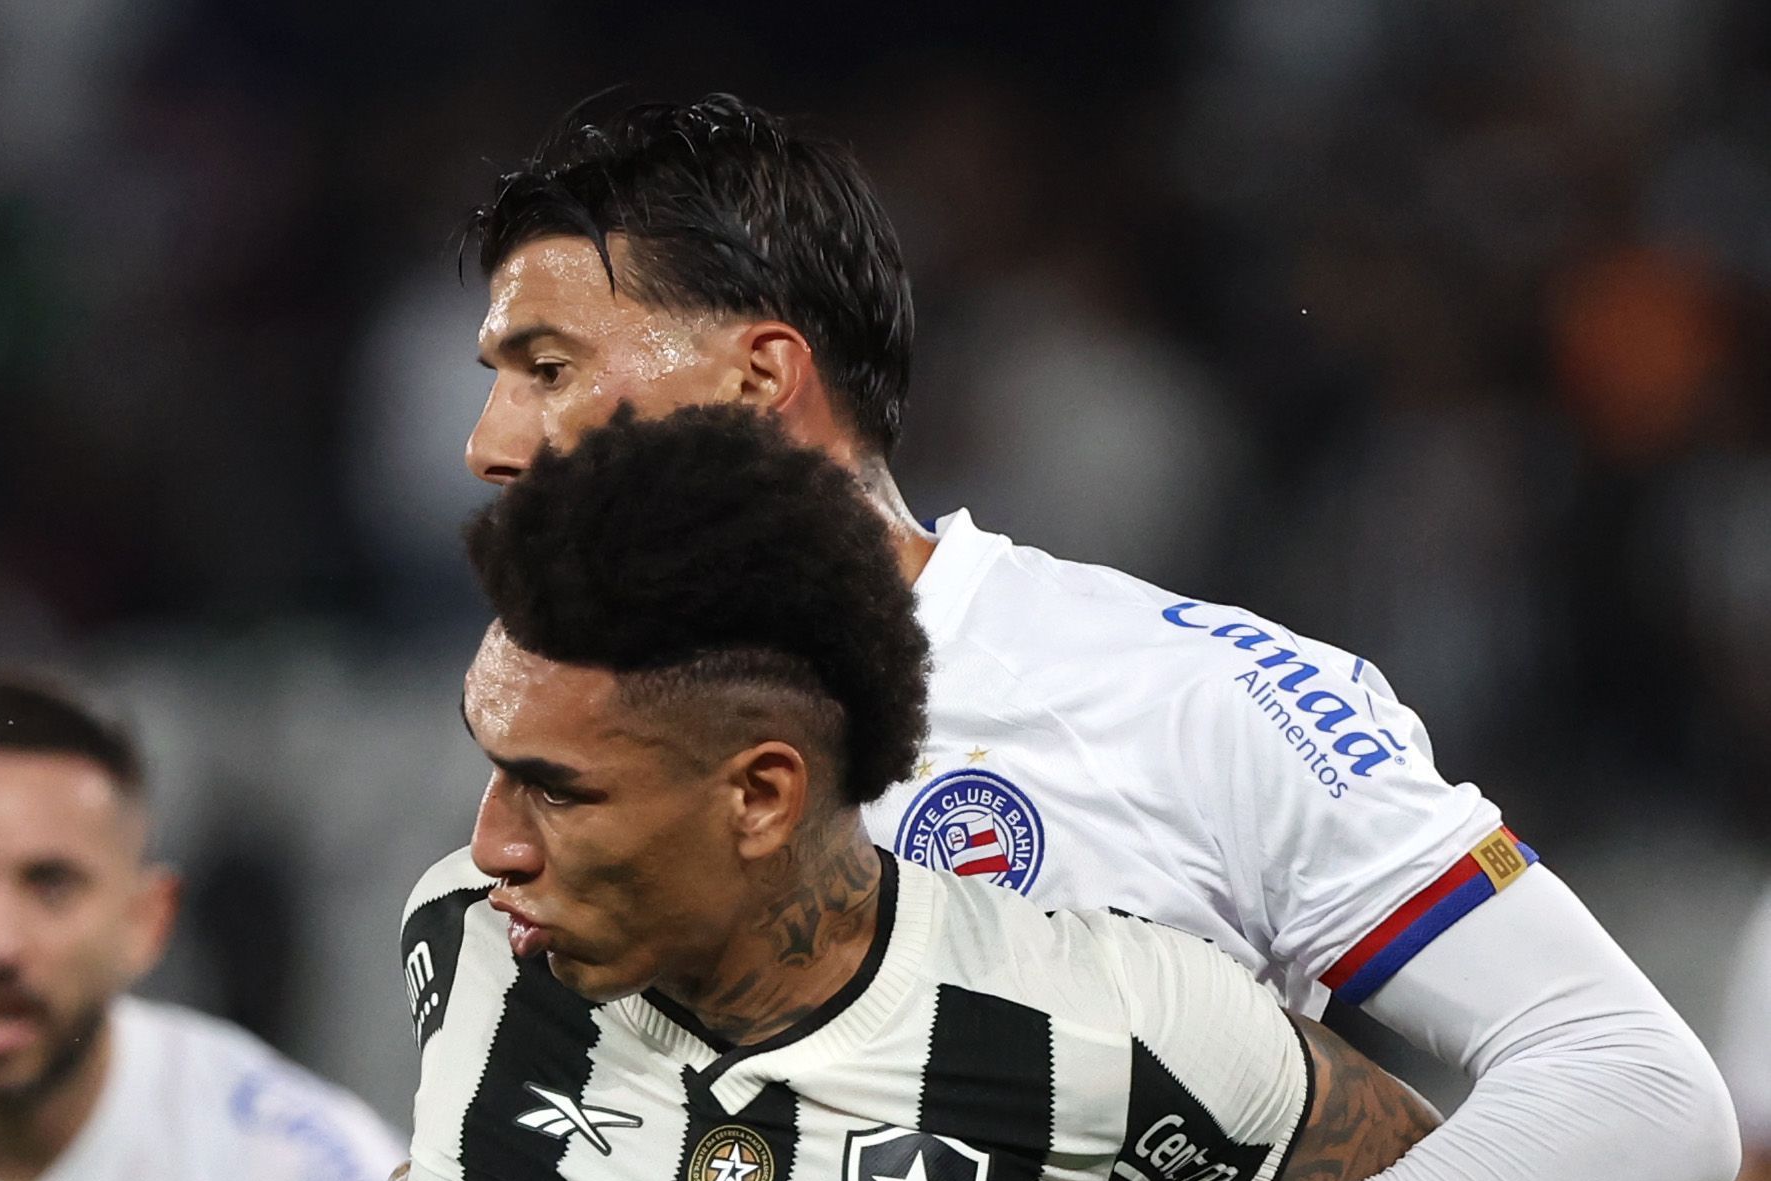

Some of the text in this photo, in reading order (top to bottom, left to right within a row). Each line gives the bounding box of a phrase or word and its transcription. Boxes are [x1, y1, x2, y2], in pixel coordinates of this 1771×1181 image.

[1234, 669, 1349, 799] Alimentos
[911, 787, 1032, 872] ORTE CLUBE BAHIA
